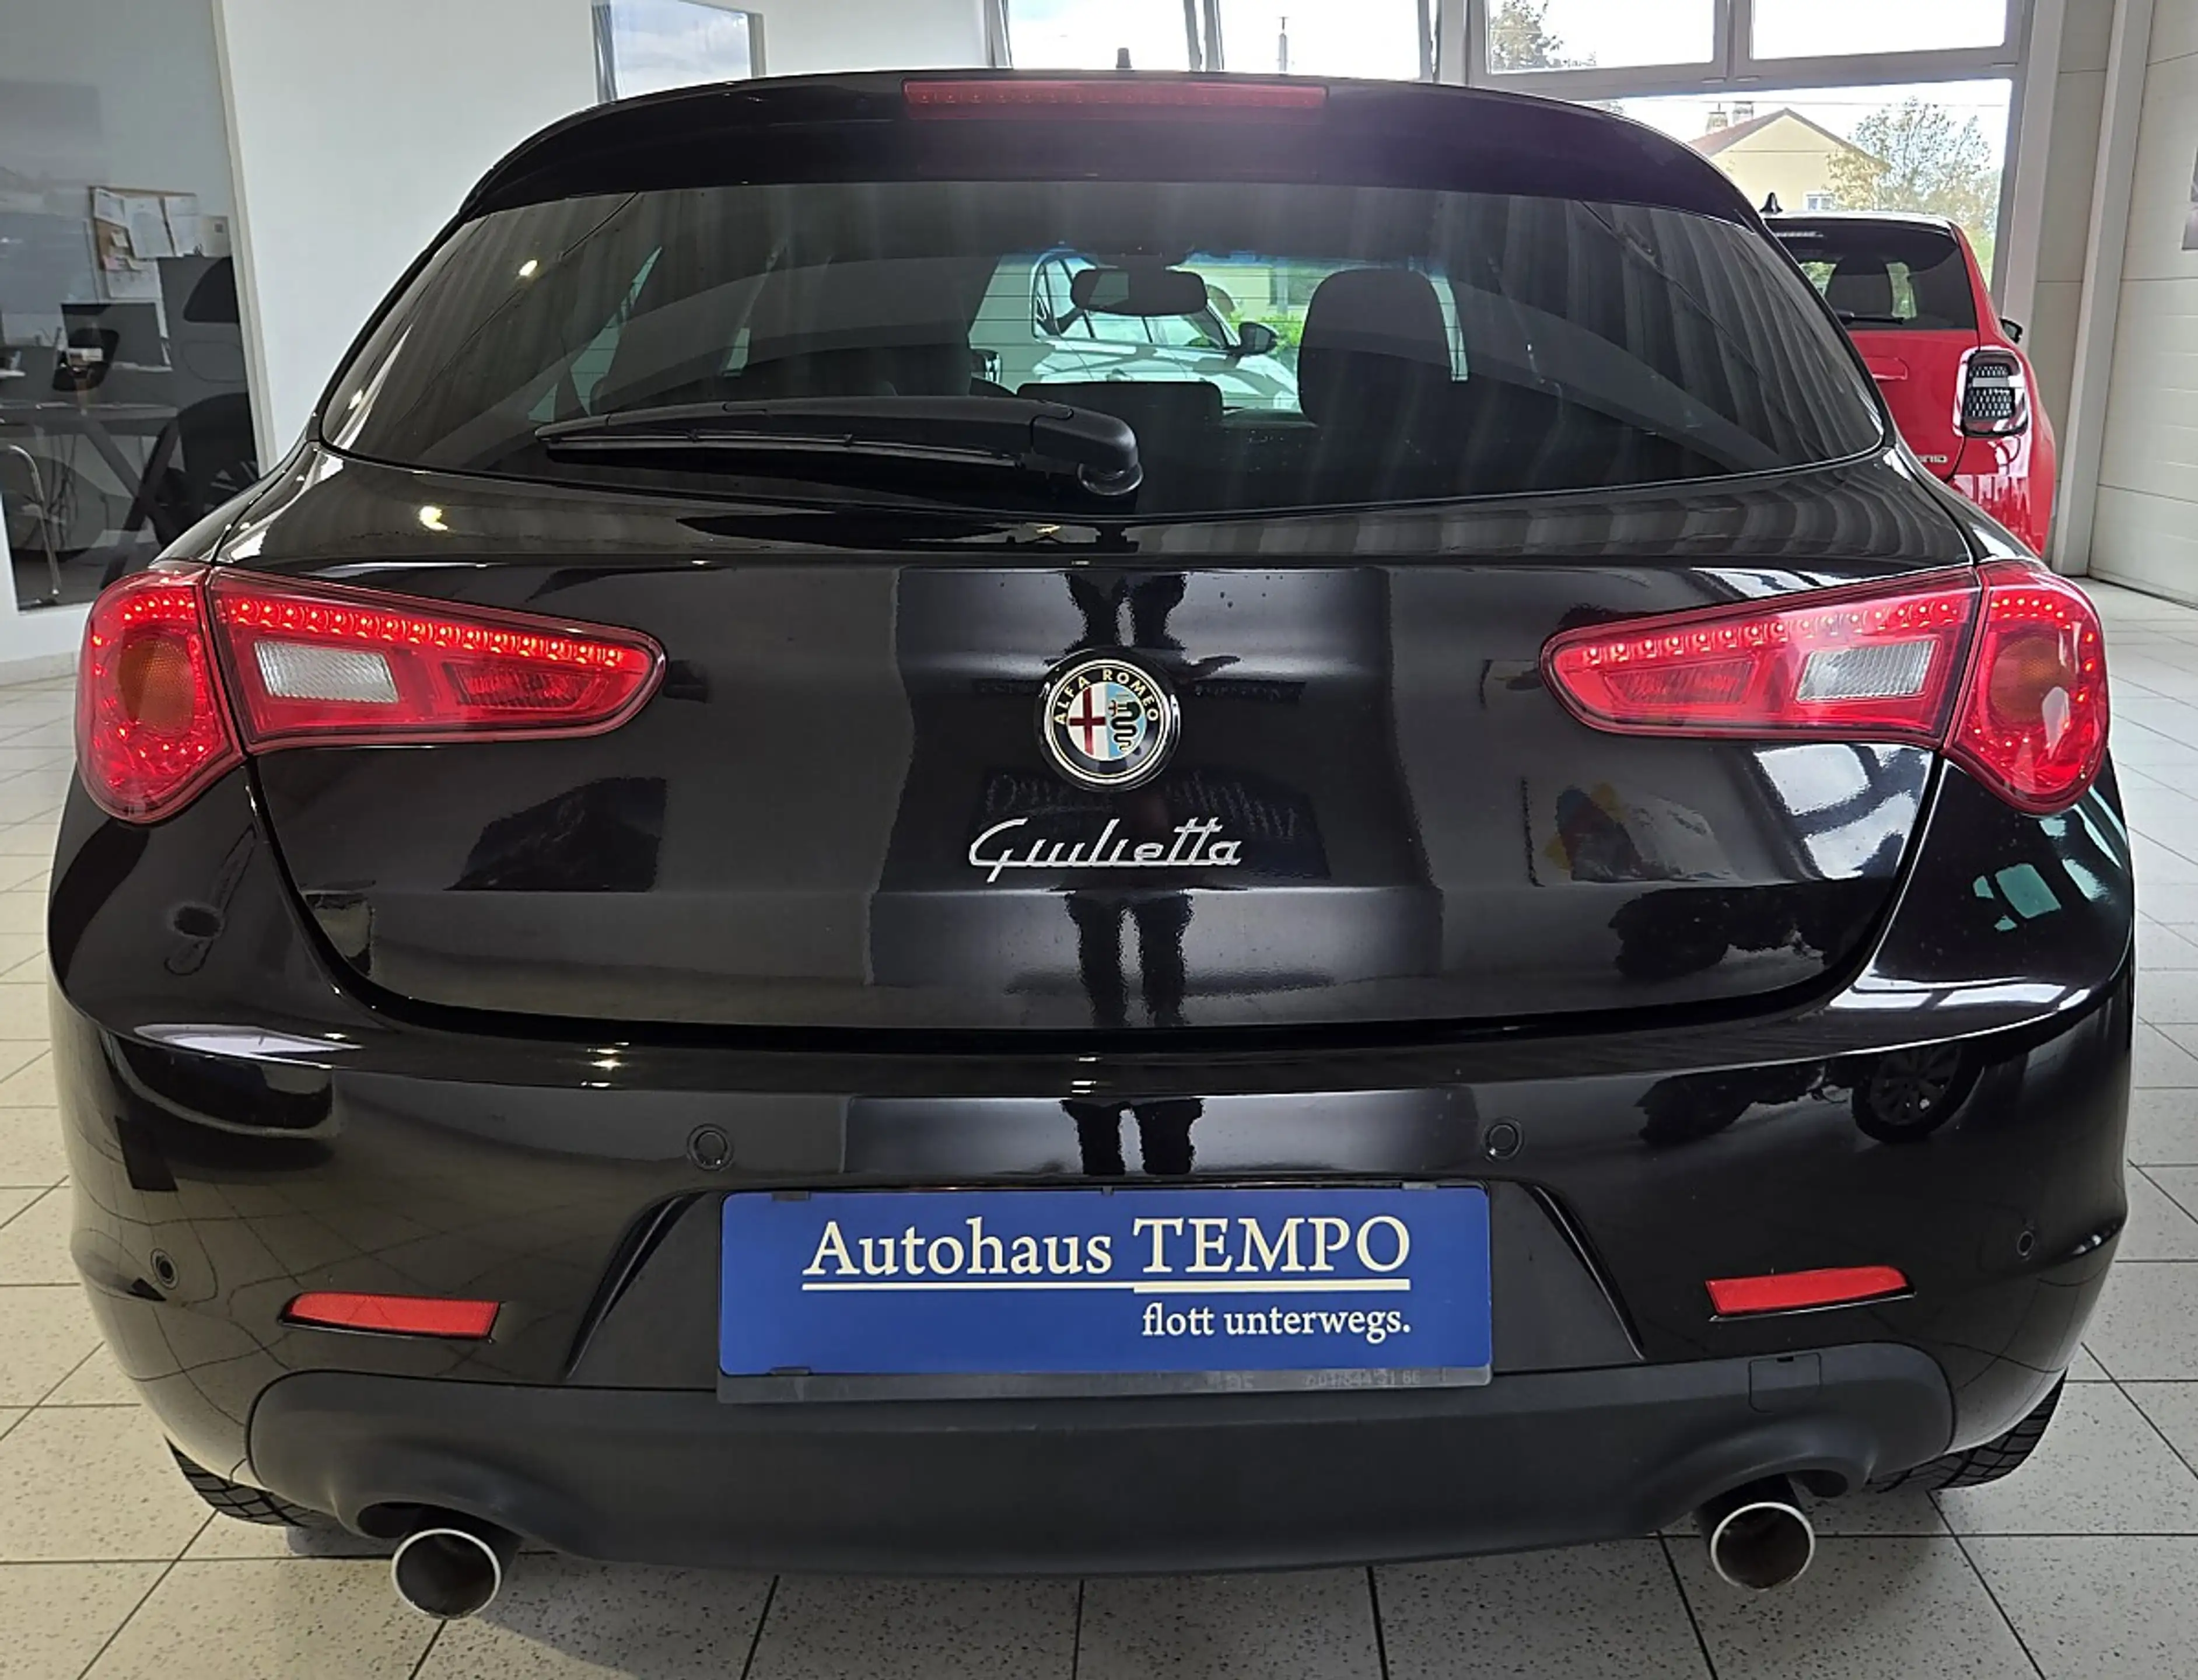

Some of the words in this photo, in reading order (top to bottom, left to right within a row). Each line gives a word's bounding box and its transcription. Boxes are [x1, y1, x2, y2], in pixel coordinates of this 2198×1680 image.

[1054, 676, 1090, 724] ALFA
[1102, 669, 1158, 721] ROMEO
[969, 817, 1242, 883] Giulietta
[802, 1216, 1112, 1275] Autohaus
[1133, 1216, 1410, 1272] TEMPO
[1142, 1302, 1214, 1336] flott
[1223, 1307, 1410, 1344] unterwegs.
